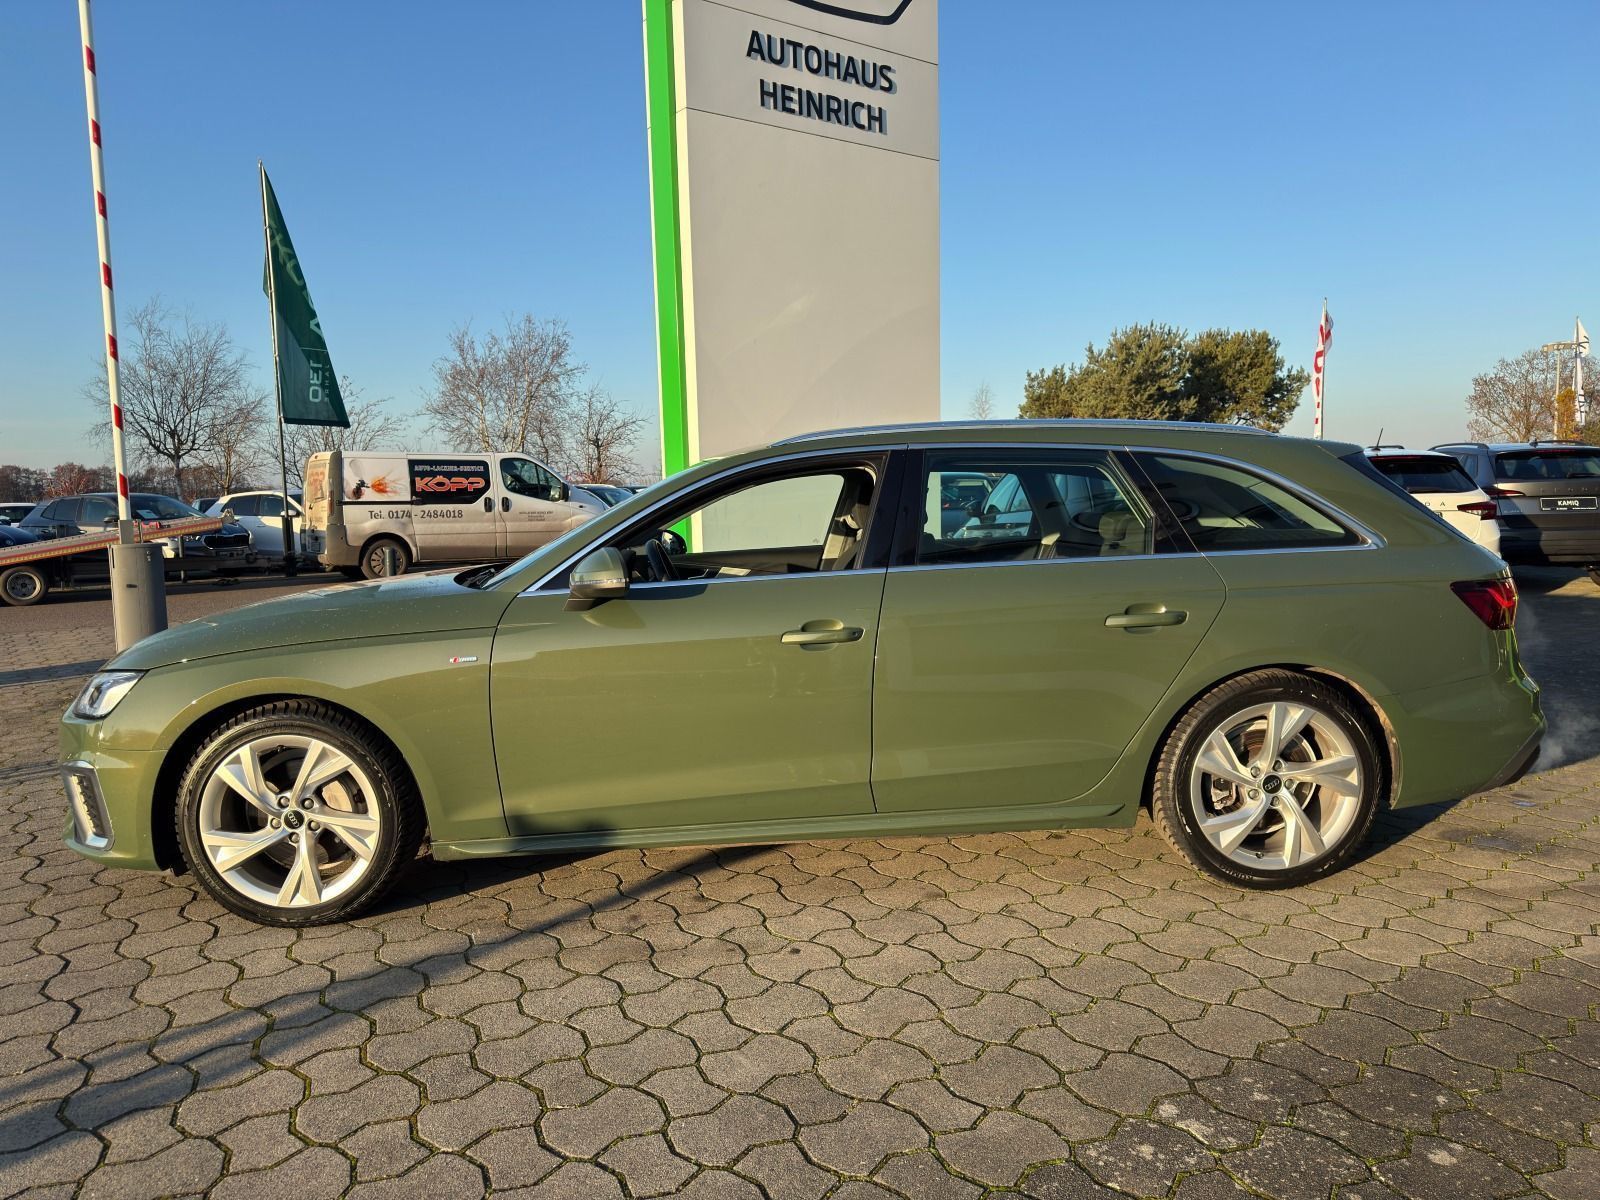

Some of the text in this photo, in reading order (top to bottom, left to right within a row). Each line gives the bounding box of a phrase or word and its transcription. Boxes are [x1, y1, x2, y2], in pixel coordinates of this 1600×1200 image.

[746, 30, 897, 95] AUTOHAUS
[759, 78, 887, 135] HEINRICH
[368, 510, 385, 520] Tel.
[387, 509, 412, 519] 0174
[420, 509, 464, 519] 2484018
